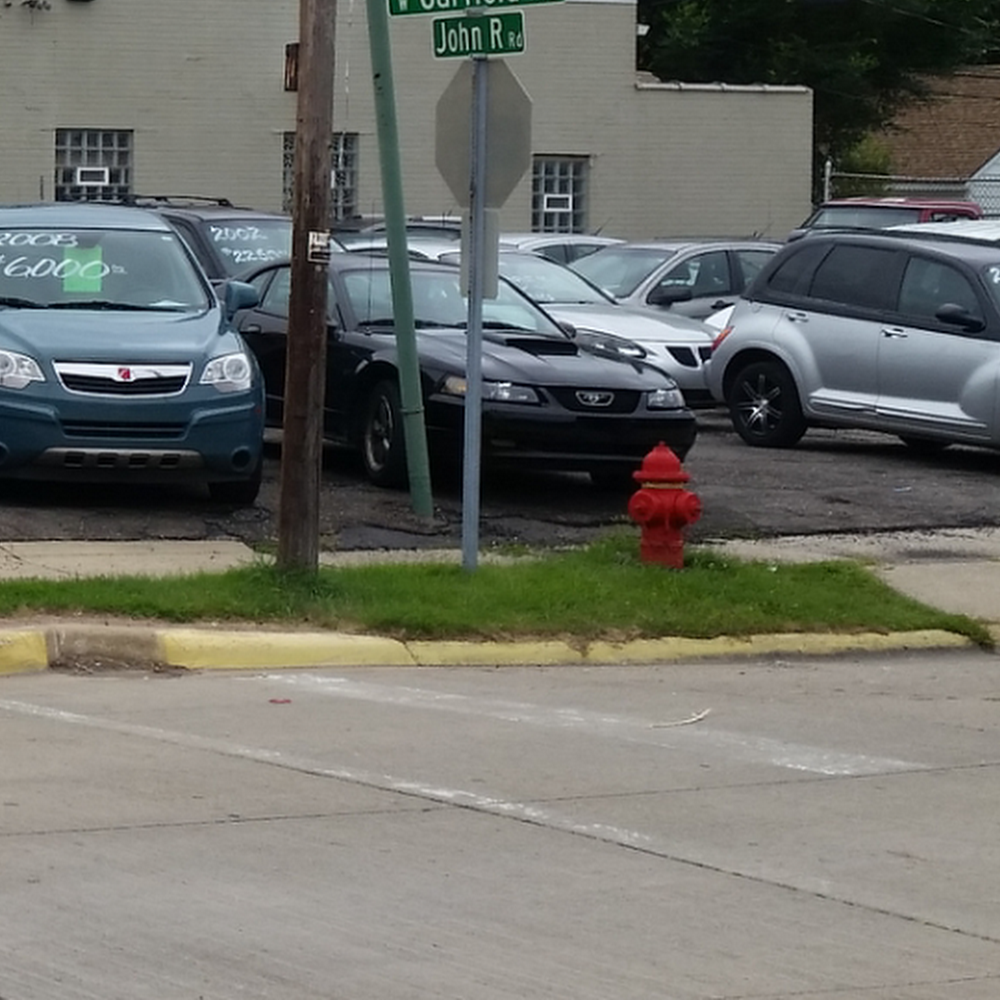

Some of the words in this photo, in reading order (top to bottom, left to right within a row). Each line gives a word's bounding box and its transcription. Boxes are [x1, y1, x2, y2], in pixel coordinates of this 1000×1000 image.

[436, 20, 483, 54] John
[489, 17, 504, 49] R
[508, 31, 524, 49] Rd
